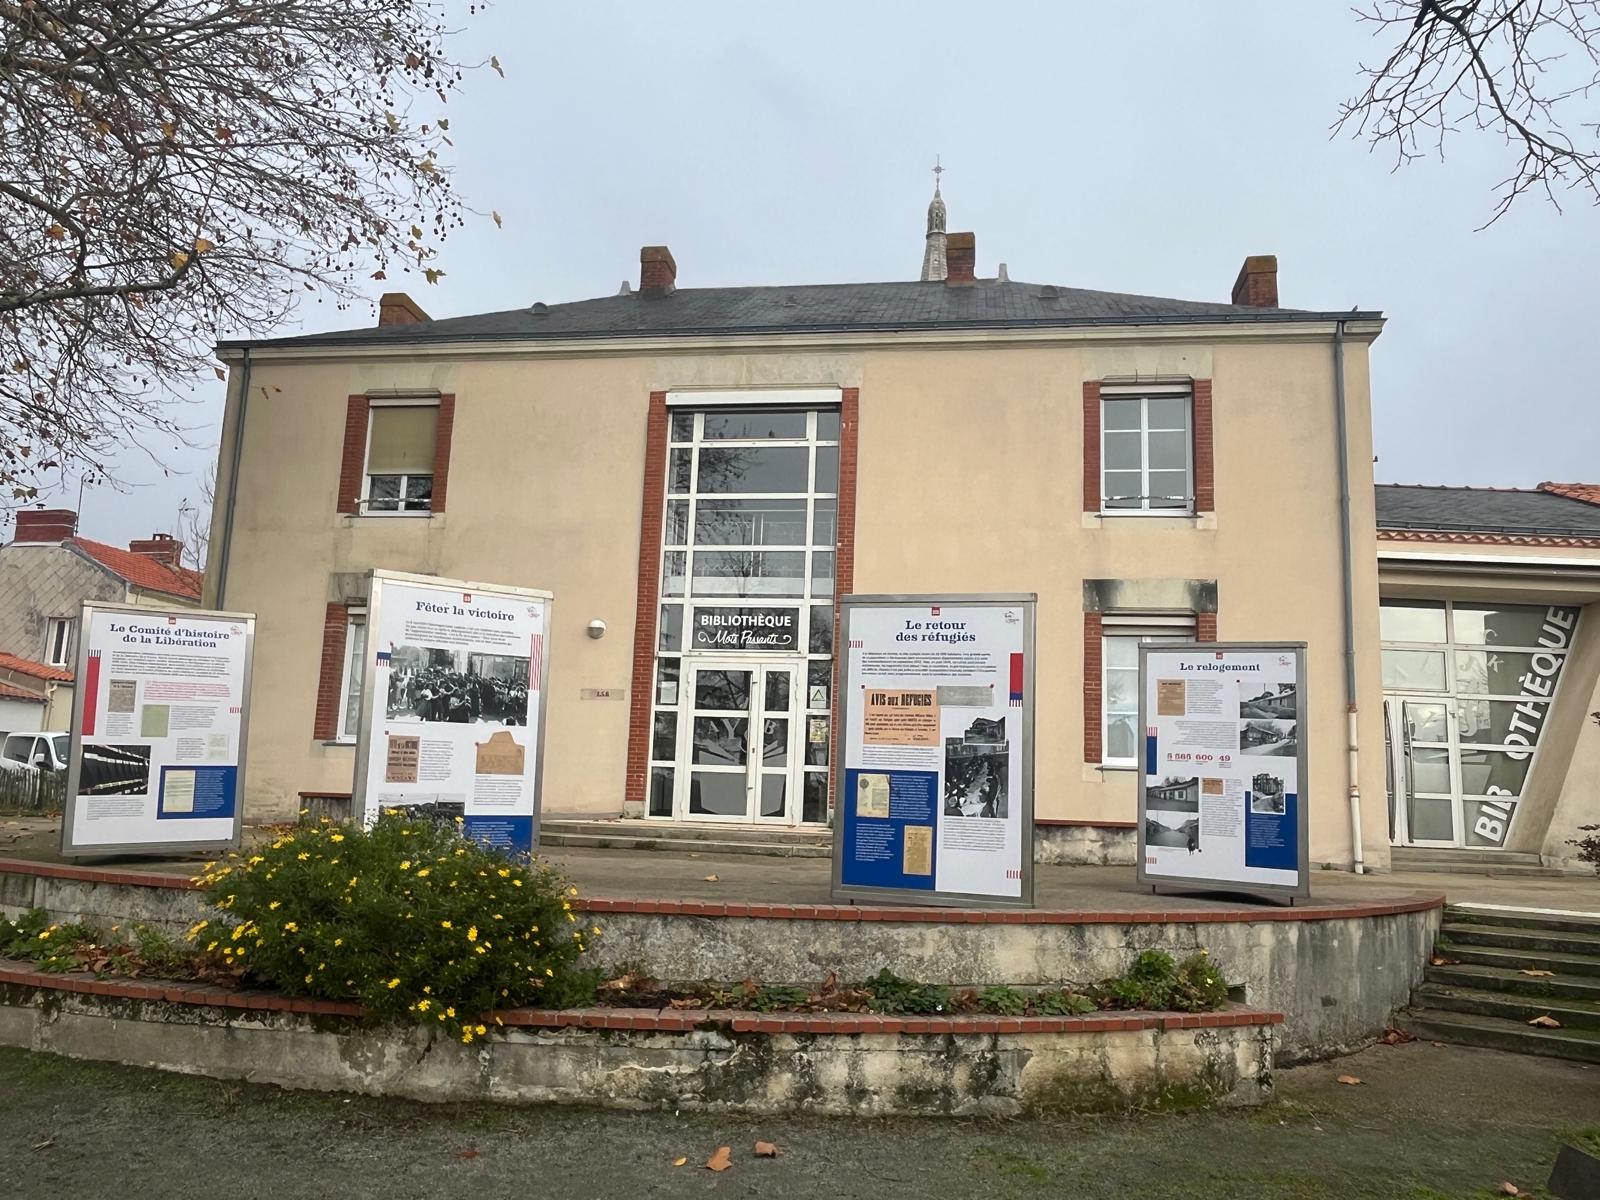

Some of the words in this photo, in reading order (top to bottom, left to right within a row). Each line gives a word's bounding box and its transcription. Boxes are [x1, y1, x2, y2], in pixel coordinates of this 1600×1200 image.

[416, 601, 450, 615] Fêter
[453, 605, 465, 616] la
[468, 609, 515, 622] victoire
[702, 614, 792, 628] BIBLIOTHÈQUE
[905, 620, 922, 630] Le
[925, 620, 966, 630] retour
[110, 624, 126, 633] Le
[128, 625, 172, 636] Comité
[174, 627, 230, 640] d'histoire
[698, 630, 740, 644] Mots
[896, 632, 918, 642] des
[921, 631, 976, 644] réfugiés
[122, 634, 137, 644] de
[140, 635, 152, 644] la
[155, 636, 217, 648] Libération
[1180, 662, 1194, 672] Le
[1196, 663, 1260, 673] relogement
[870, 693, 886, 706] AVIS
